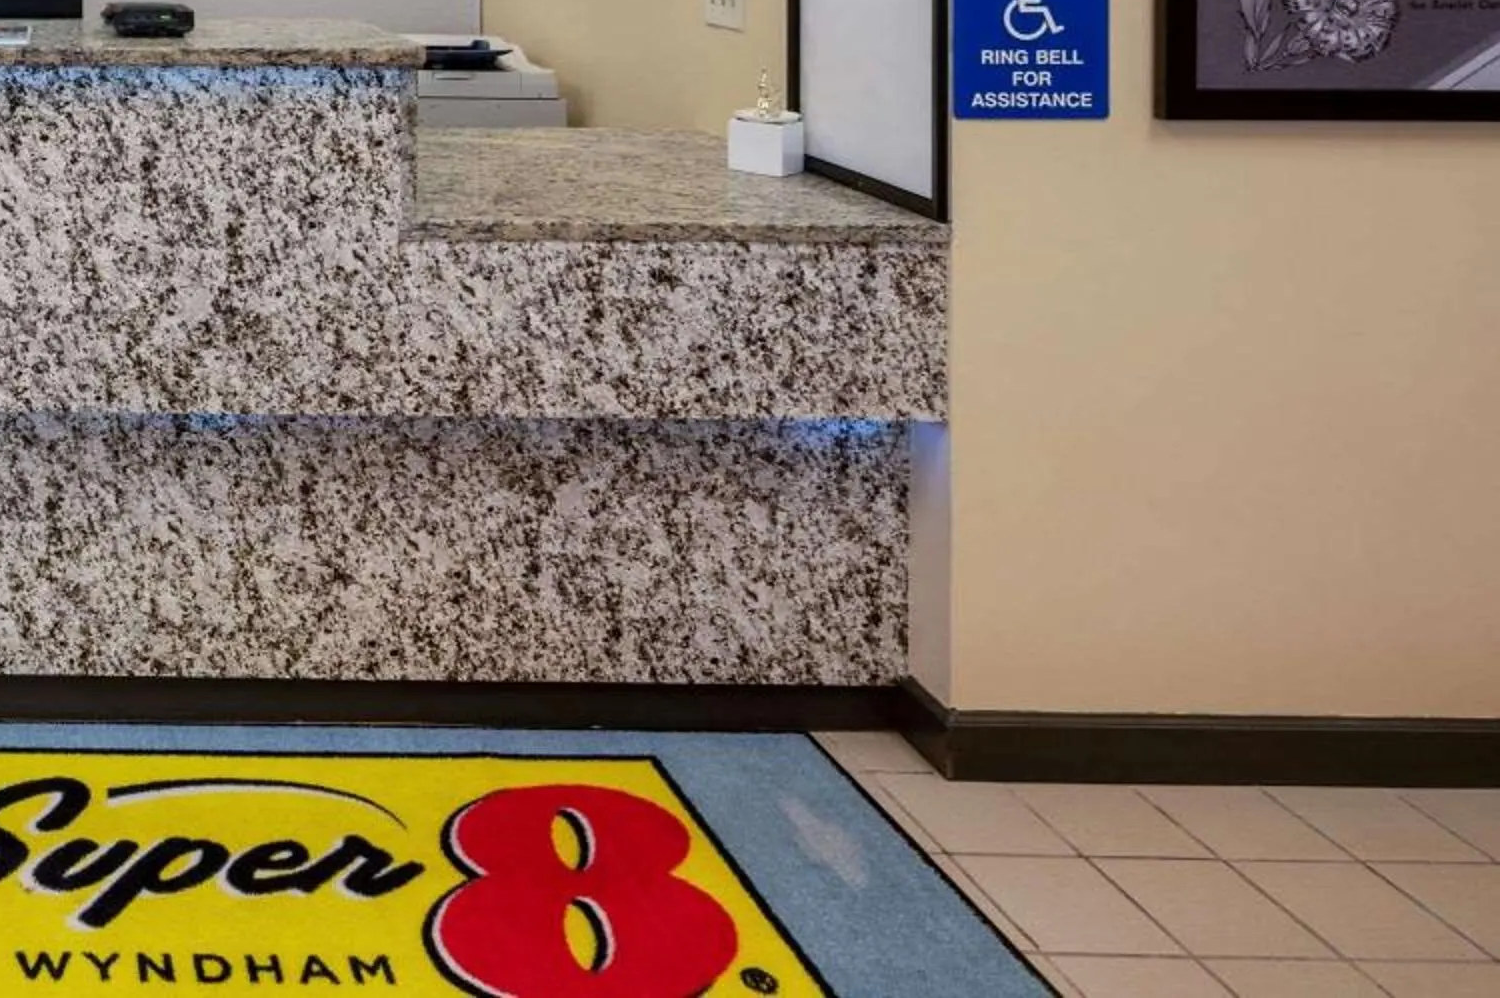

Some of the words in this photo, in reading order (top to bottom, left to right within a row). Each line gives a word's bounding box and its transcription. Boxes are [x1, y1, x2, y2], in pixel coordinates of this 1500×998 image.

[980, 49, 1029, 65] RING
[1035, 49, 1084, 65] BELL
[1012, 71, 1052, 86] FOR
[971, 92, 1093, 108] ASSISTANCE
[423, 784, 740, 998] 8
[15, 950, 400, 986] WYNDHAM
